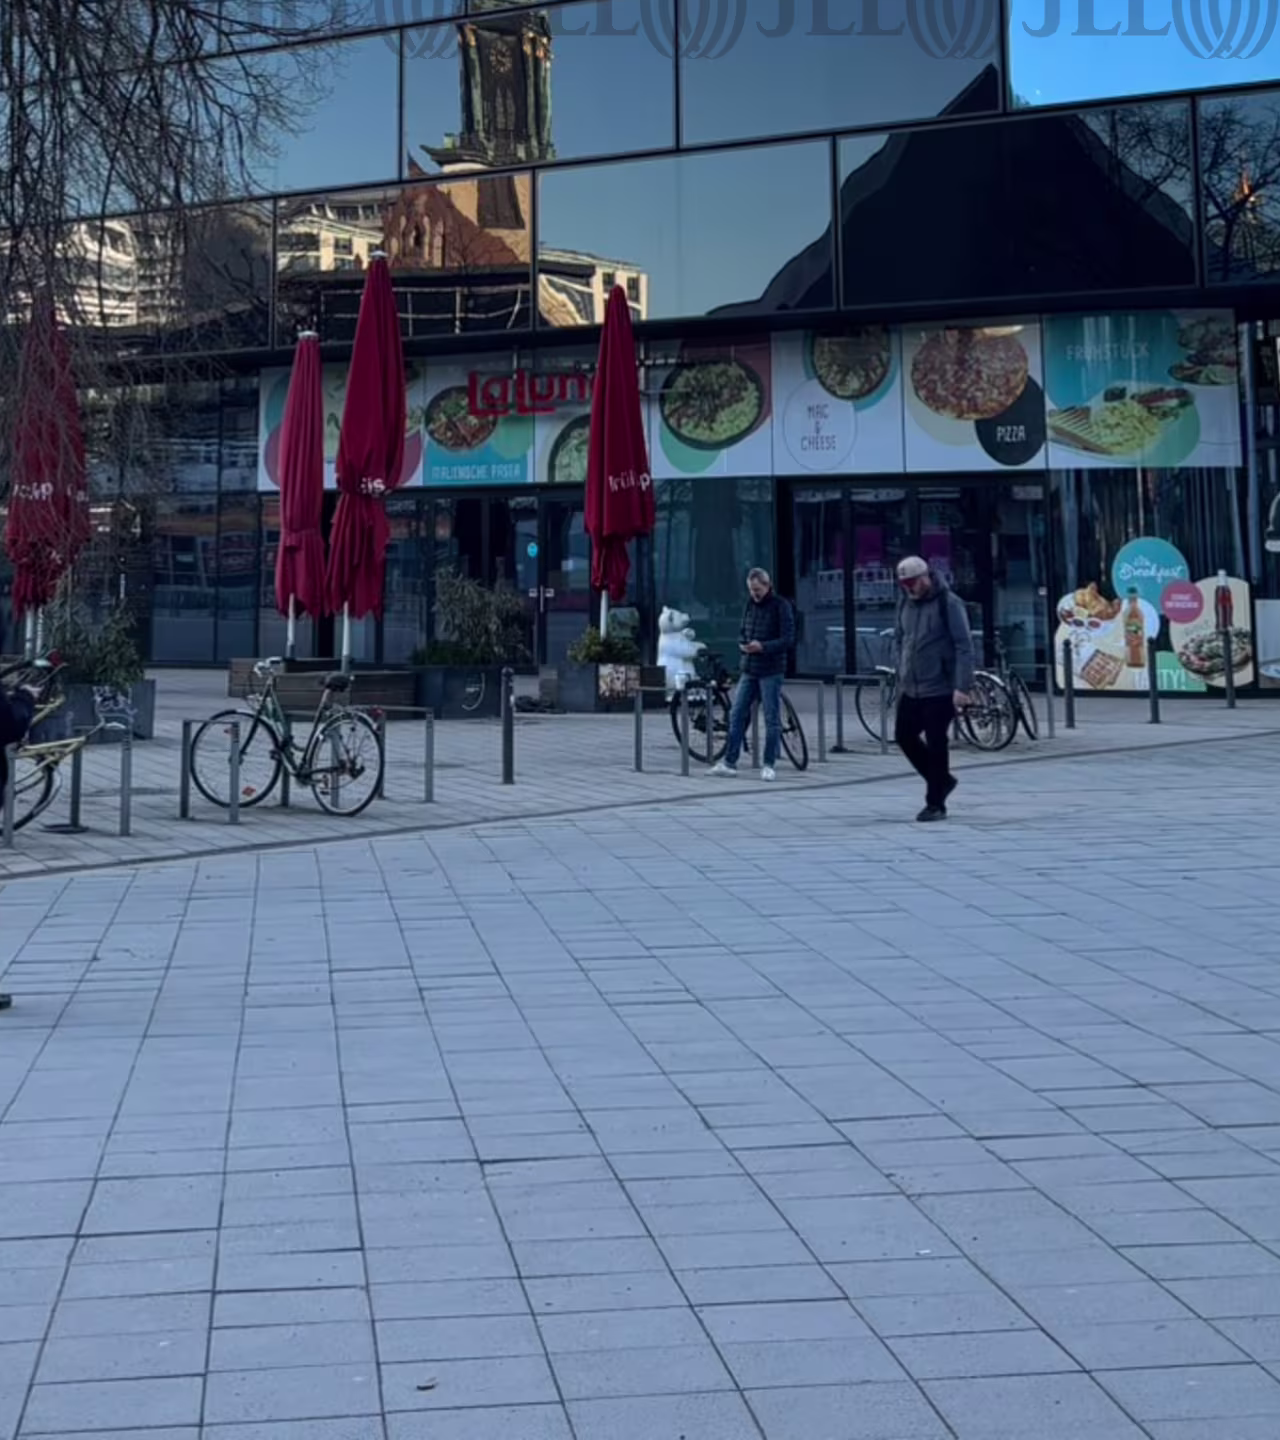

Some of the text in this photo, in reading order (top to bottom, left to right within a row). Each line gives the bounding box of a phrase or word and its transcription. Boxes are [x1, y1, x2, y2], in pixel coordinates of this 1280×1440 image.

[807, 404, 829, 420] MAC
[800, 434, 836, 452] CHEESE
[996, 425, 1026, 443] PIZZA
